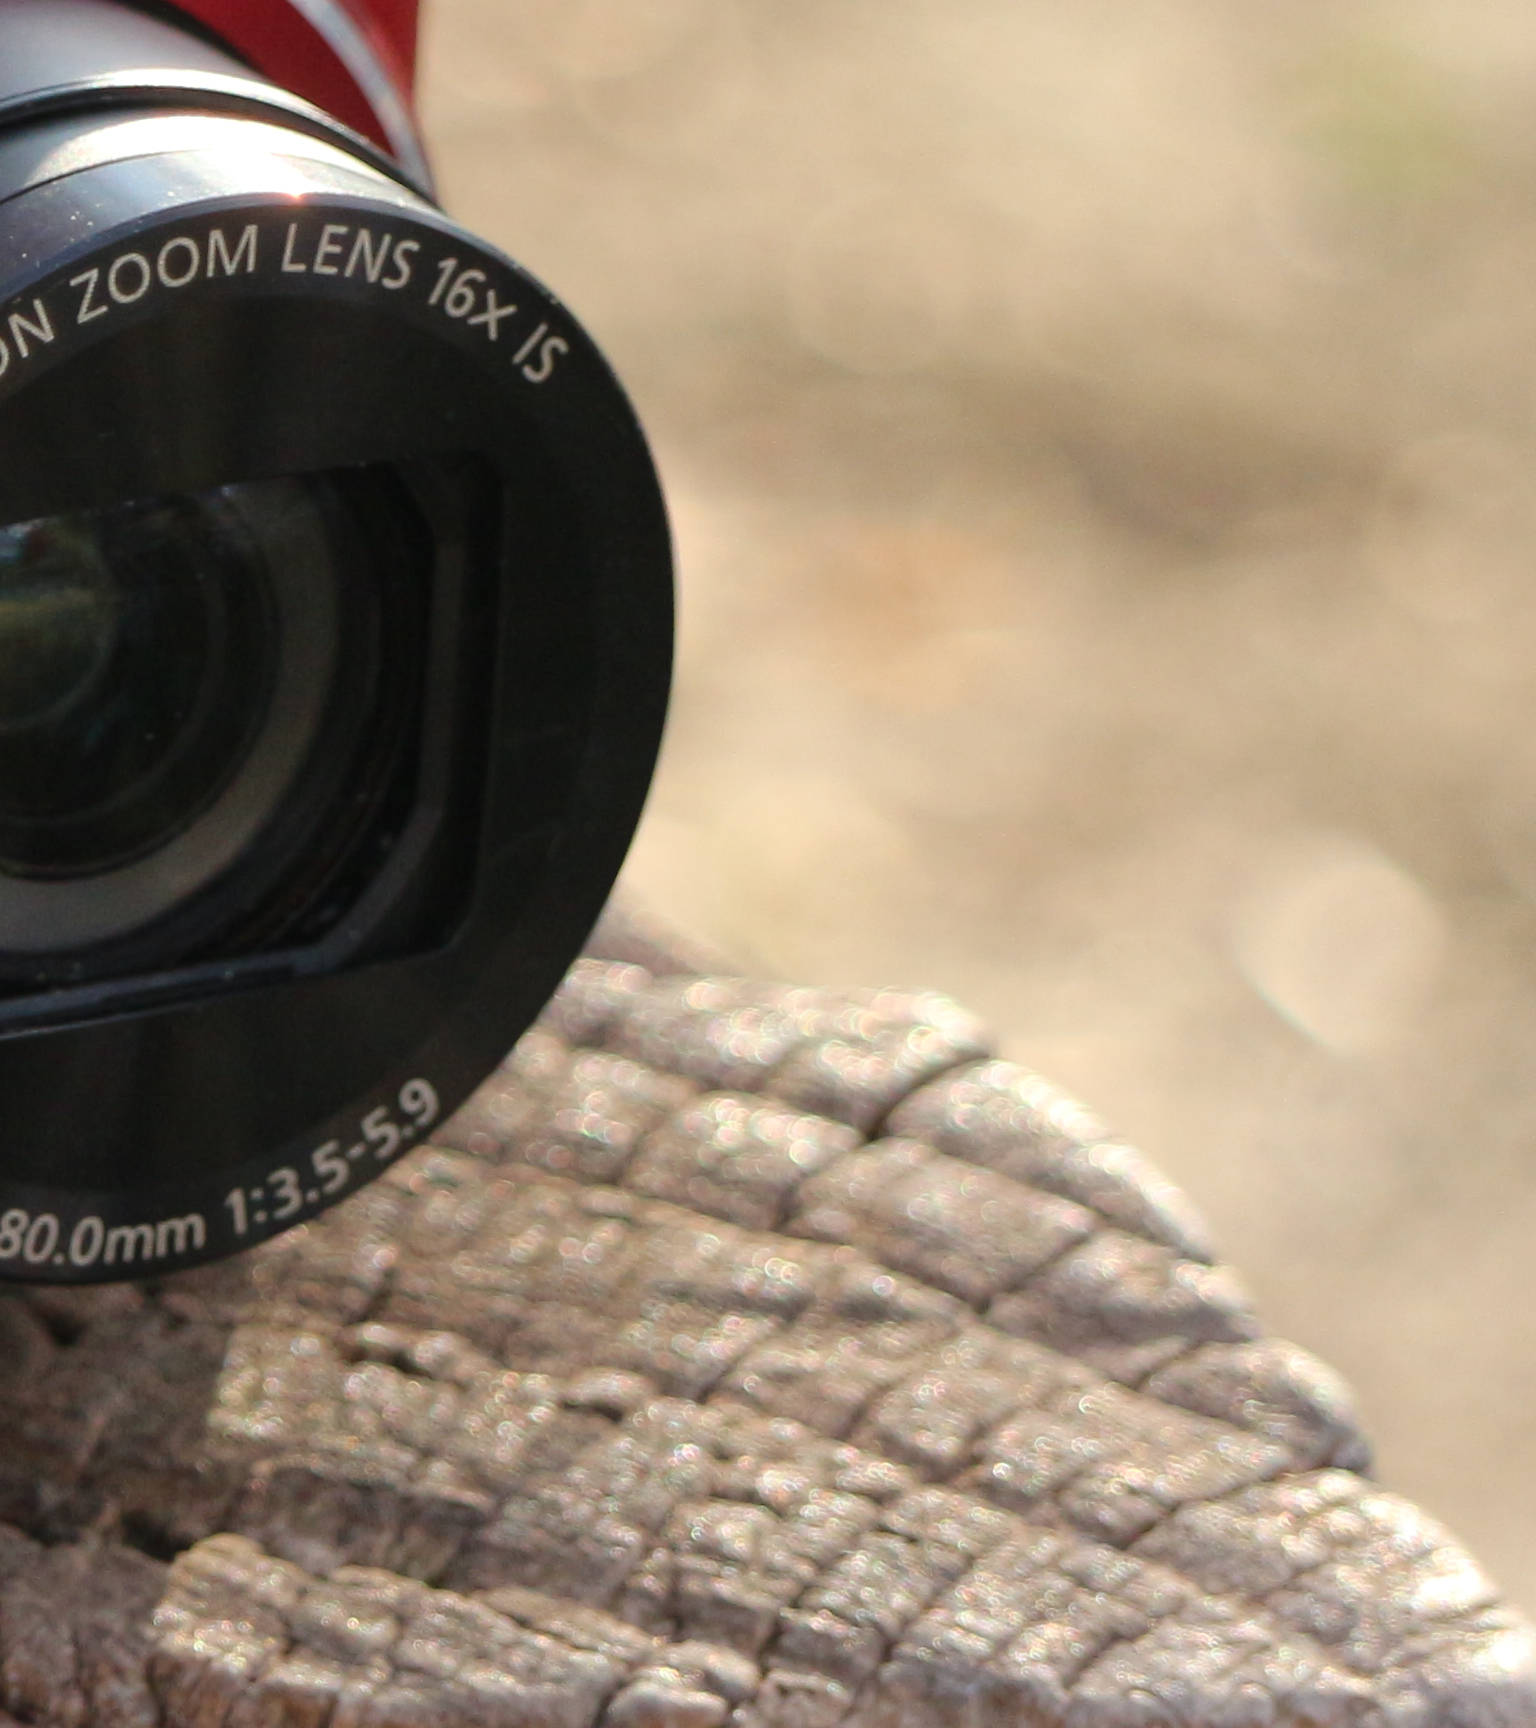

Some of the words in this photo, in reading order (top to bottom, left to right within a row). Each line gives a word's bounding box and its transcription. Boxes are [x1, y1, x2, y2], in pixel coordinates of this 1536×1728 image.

[70, 224, 259, 325] ZOOM
[281, 223, 420, 290] LENS
[512, 322, 569, 383] IS
[224, 1077, 441, 1235] 1:3.5-5.9
